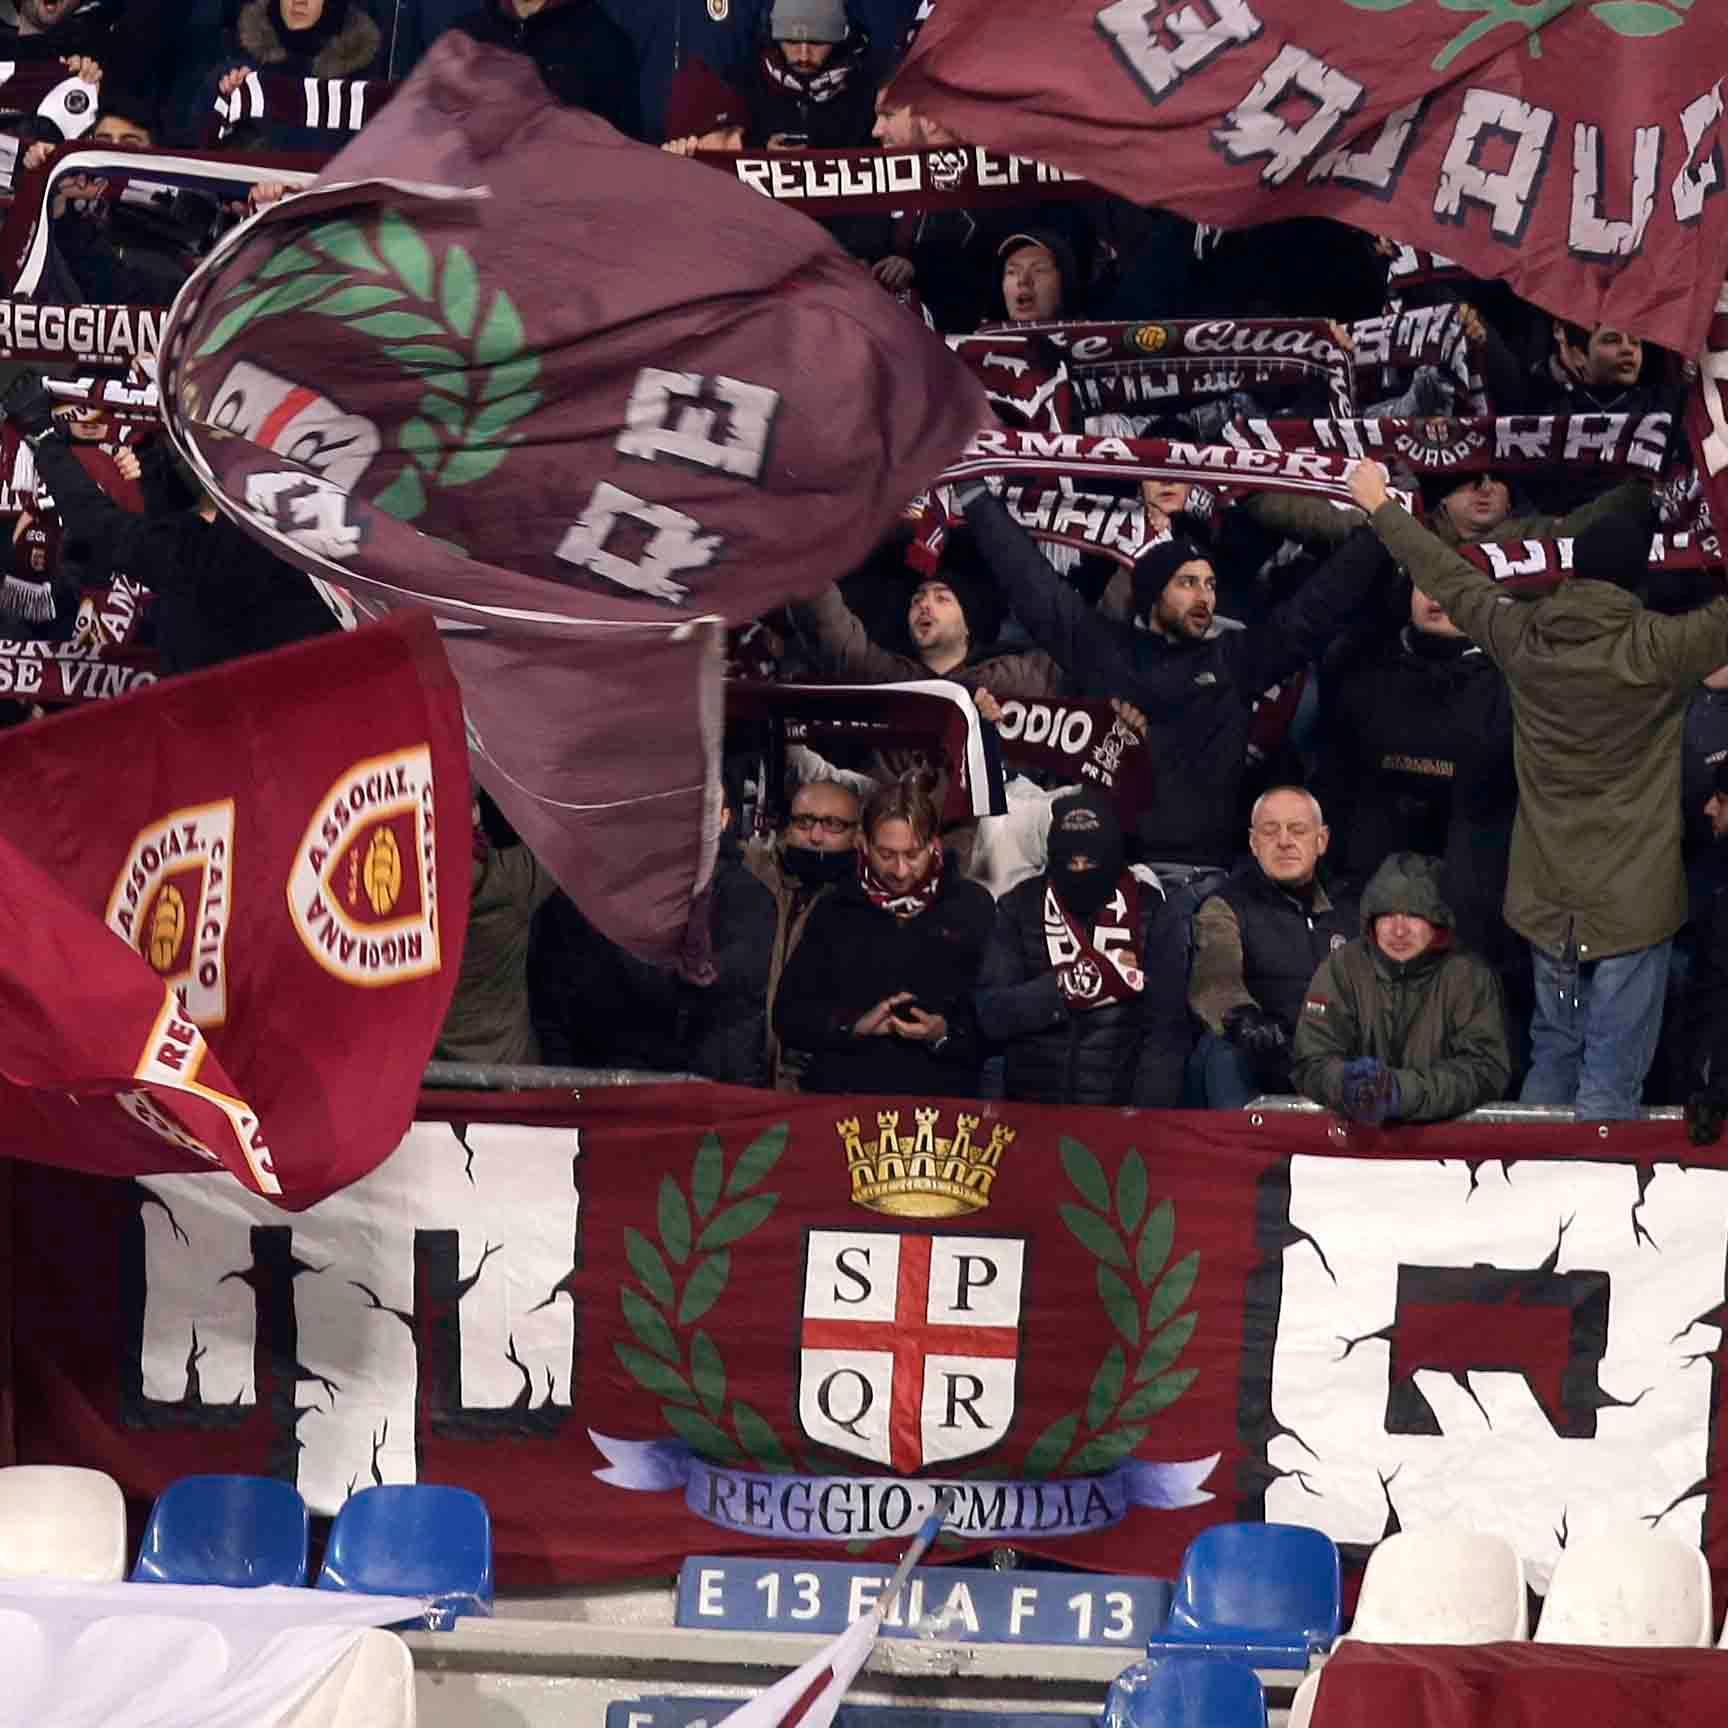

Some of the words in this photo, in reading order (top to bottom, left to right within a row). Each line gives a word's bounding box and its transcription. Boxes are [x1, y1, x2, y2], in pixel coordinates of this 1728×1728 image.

[735, 155, 922, 200] REGGIO
[999, 699, 1095, 756] ODIO
[310, 766, 417, 877] ASSOCIAZ.
[118, 824, 208, 939] ASSOCIAZ.
[198, 841, 226, 988] CALCIO
[832, 1245, 873, 1303] S
[948, 1254, 998, 1311] P
[816, 1367, 875, 1440] Q
[938, 1371, 993, 1430] R
[705, 1475, 911, 1534] REGGIO
[929, 1477, 1115, 1534] EMILIA
[698, 1568, 725, 1617] E
[756, 1571, 822, 1620] 13
[1008, 1586, 1037, 1635] F
[1067, 1591, 1134, 1642] 13
